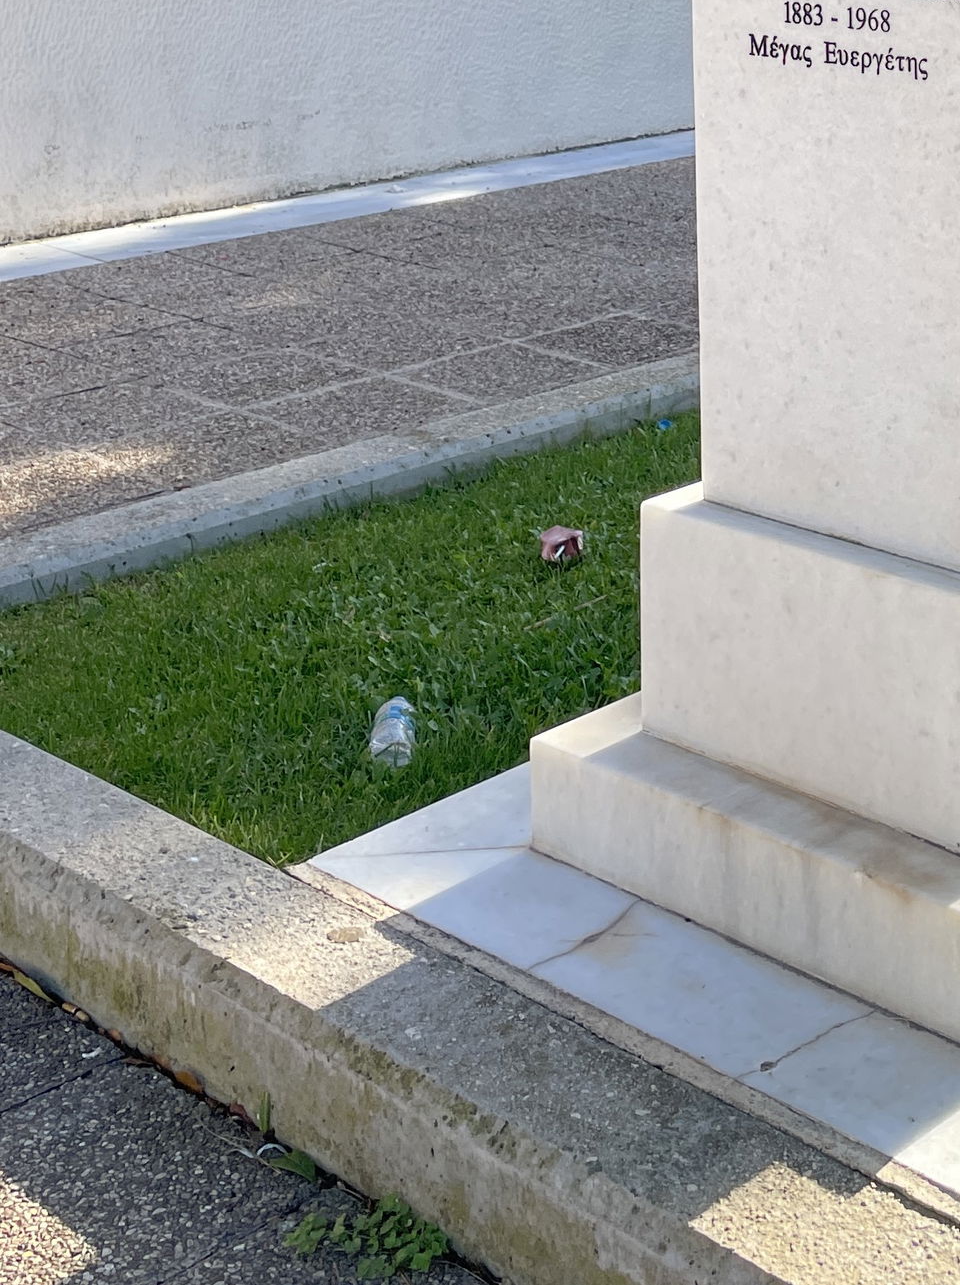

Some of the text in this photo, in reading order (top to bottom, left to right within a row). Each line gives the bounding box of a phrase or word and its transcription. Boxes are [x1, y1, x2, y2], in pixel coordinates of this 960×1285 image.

[783, 0, 824, 27] 1883
[846, 6, 892, 33] 1968
[748, 33, 929, 81] Μέγας Ευεργέτης
